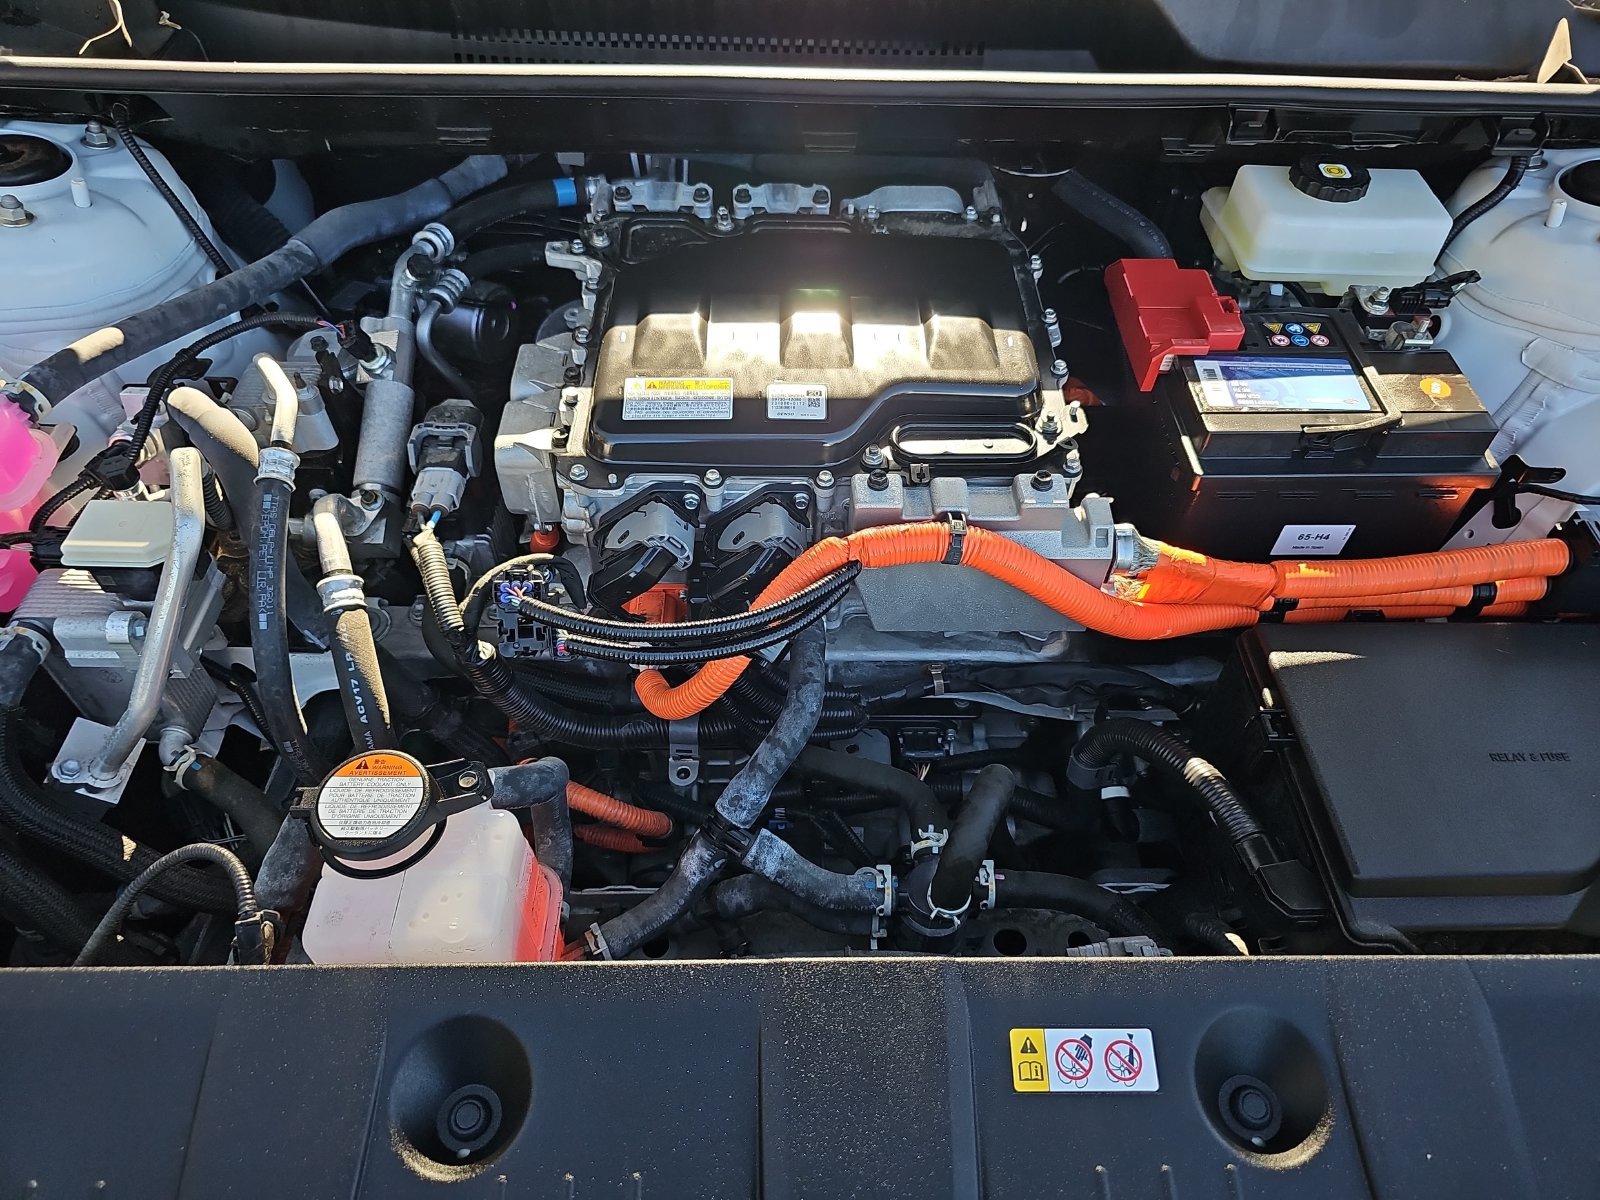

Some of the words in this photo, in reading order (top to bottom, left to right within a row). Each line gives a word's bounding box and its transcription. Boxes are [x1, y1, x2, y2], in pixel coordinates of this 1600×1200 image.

[1297, 533, 1331, 541] 65-H4
[350, 679, 368, 724] ACV17
[1488, 752, 1526, 762] RELAY
[1540, 752, 1571, 762] FUSE
